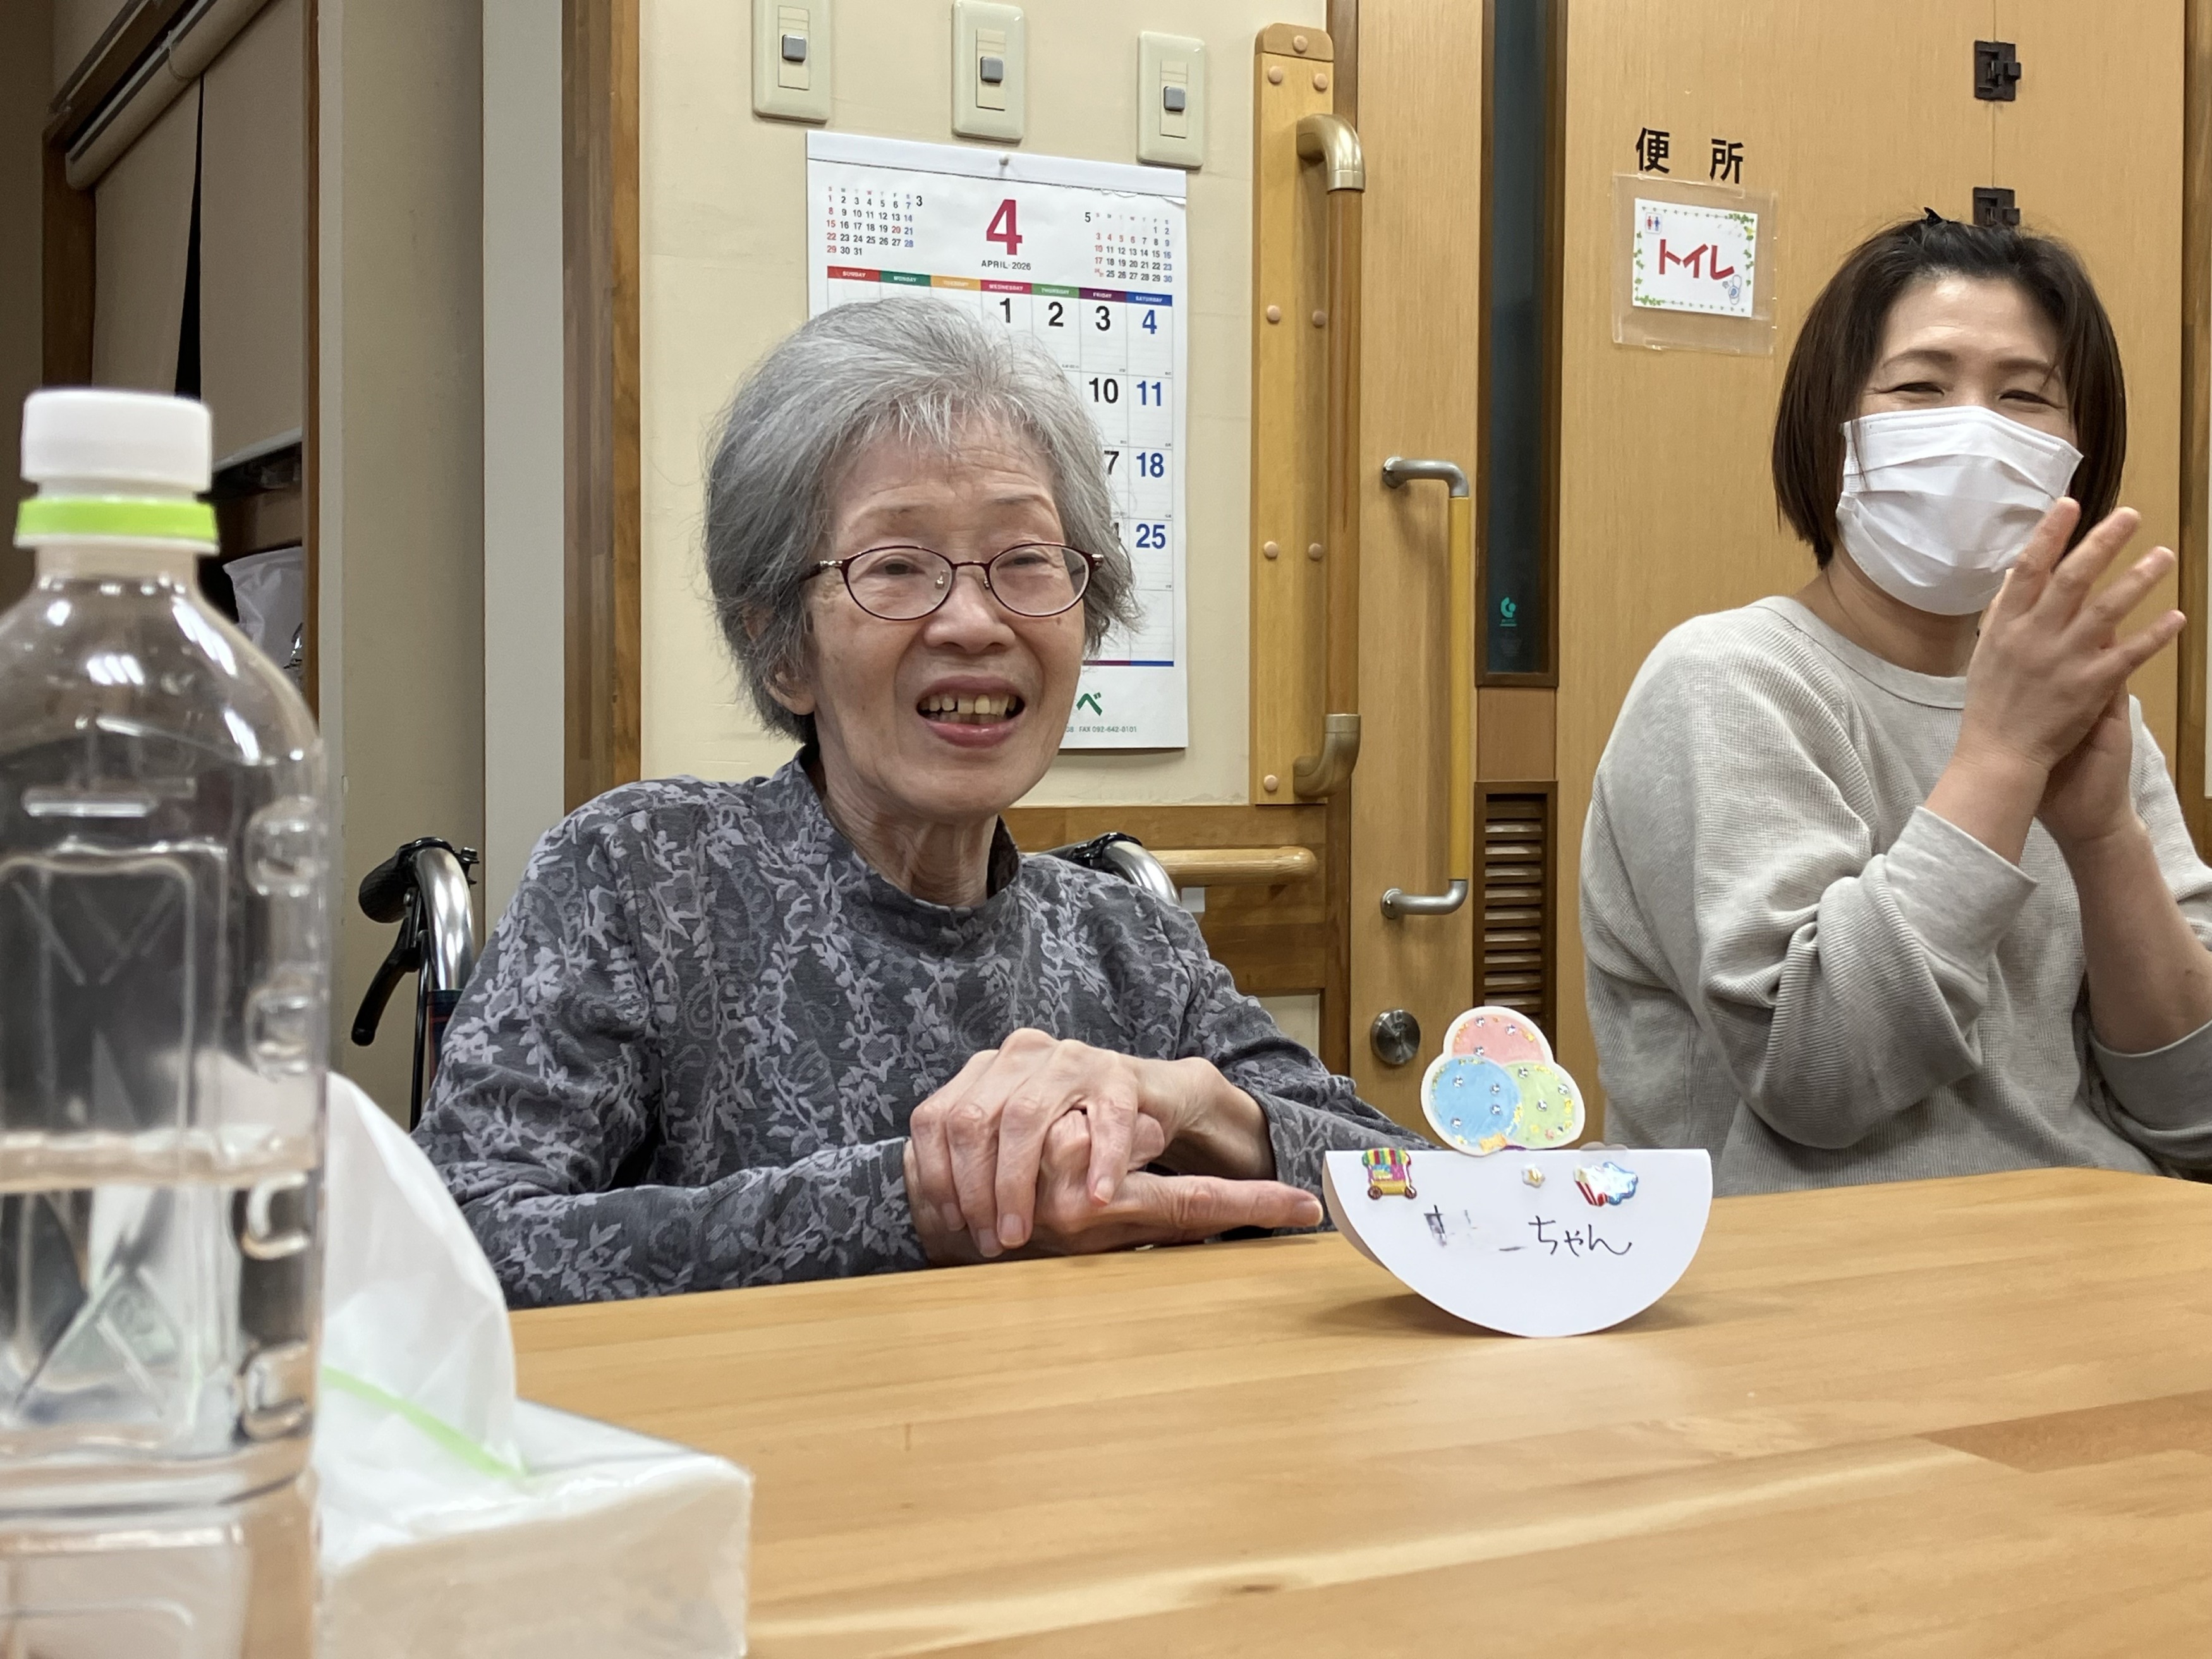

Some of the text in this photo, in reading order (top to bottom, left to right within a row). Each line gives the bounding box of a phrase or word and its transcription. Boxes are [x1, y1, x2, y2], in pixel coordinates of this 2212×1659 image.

[1636, 127, 1744, 184] 便所
[916, 195, 922, 206] 3
[986, 198, 1023, 255] 4
[1085, 212, 1091, 222] 5
[981, 260, 1031, 270] APRIL 2026
[1659, 238, 1735, 281] トイレ
[1000, 298, 1157, 334] 1 2 3 4
[1089, 377, 1161, 406] 10 11
[1136, 453, 1164, 478] 18
[1136, 524, 1165, 549] 25
[1528, 1215, 1633, 1258] ちゃん
